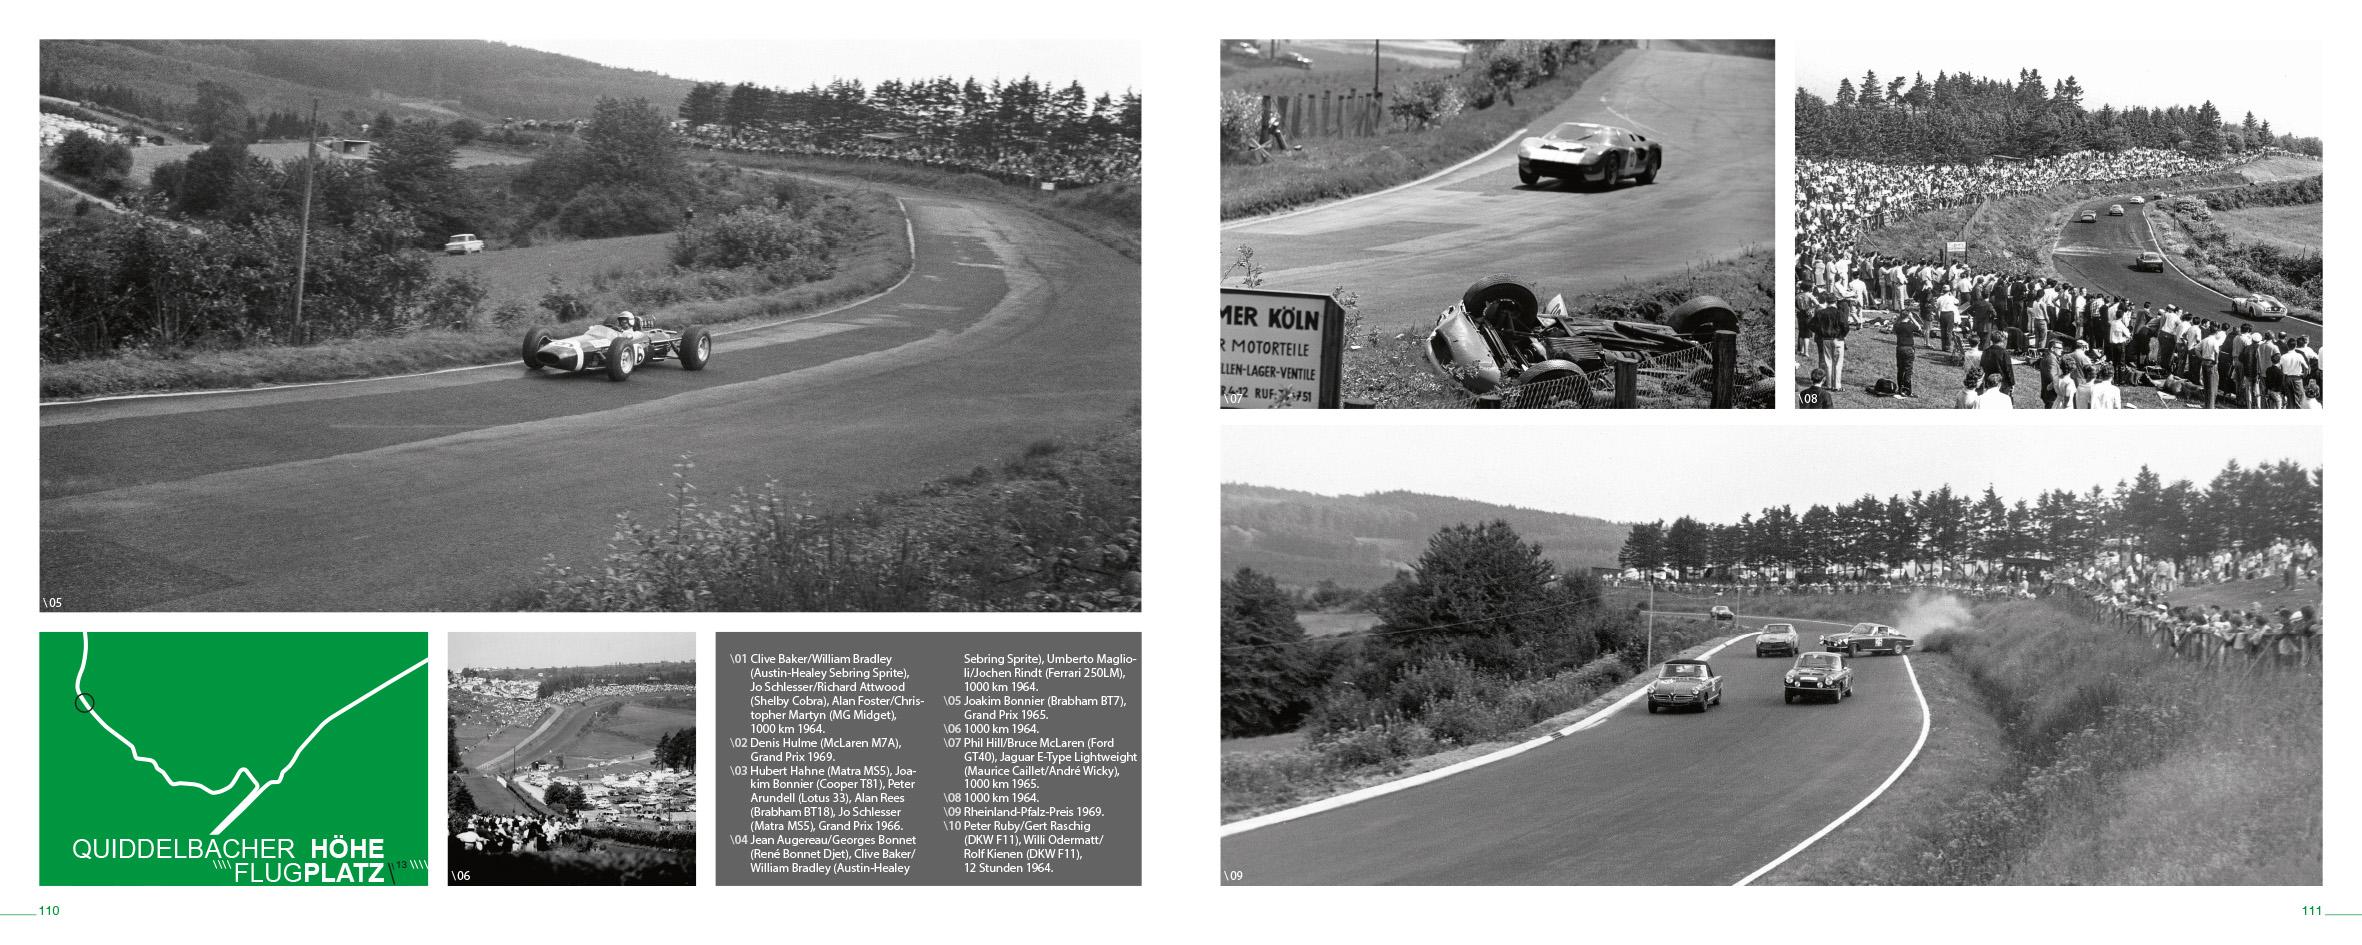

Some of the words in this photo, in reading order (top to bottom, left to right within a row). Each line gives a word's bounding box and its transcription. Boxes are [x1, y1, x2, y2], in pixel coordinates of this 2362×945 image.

[1269, 306, 1319, 331] KÖLN
[1232, 339, 1309, 357] MOTORTEILE
[1221, 363, 1316, 381] LLEN-LAGER-VENTILE
[729, 654, 747, 664] \01
[750, 654, 776, 664] Clive
[778, 654, 851, 667] Baker/William
[853, 654, 893, 667] Bradley
[964, 654, 1005, 667] Sebring
[1007, 654, 1045, 667] Sprite),
[1047, 654, 1094, 664] Umberto
[1096, 654, 1137, 667] Maglio-
[750, 668, 828, 681] (Austin-Healey
[829, 668, 871, 681] Sebring
[872, 668, 910, 681] Sprite),
[963, 668, 1012, 681] li/Jochen
[1014, 668, 1043, 678] Rindt
[1045, 668, 1082, 681] (Ferrari
[1083, 668, 1126, 681] 250LM),
[749, 682, 763, 692] Jo
[764, 682, 857, 695] Schlesser/Richard
[859, 682, 906, 692] Attwood
[964, 682, 990, 692] 1000
[991, 682, 1009, 692] km
[1011, 682, 1039, 692] 1964.
[750, 696, 790, 709] (Shelby
[791, 696, 830, 709] Cobra),
[831, 696, 856, 706] Alan
[857, 696, 925, 709] Foster/Chris-
[943, 696, 962, 706] \05
[963, 696, 1002, 706] Joakim
[1003, 696, 1045, 706] Bonnier
[1047, 696, 1099, 709] (Brabham
[1100, 696, 1127, 709] BT7),
[750, 710, 787, 723] topher
[788, 710, 827, 723] Martyn
[829, 710, 851, 723] (MG
[853, 710, 897, 723] Midget),
[964, 710, 997, 720] Grand
[999, 710, 1019, 720] Prix
[1021, 710, 1049, 720] 1965.
[750, 724, 777, 734] 1000
[778, 724, 795, 734] km
[798, 724, 826, 734] 1964.
[943, 724, 962, 734] \06
[964, 724, 991, 734] 1000
[992, 724, 1010, 734] km
[1011, 724, 1040, 734] 1964.
[729, 738, 748, 748] \02
[750, 738, 780, 748] Denis
[782, 738, 818, 748] Hulme
[820, 738, 869, 751] (McLaren
[871, 738, 902, 751] M7A),
[943, 738, 962, 748] \07
[963, 738, 984, 748] Phil
[986, 738, 1038, 751] Hill/Bruce
[1039, 738, 1085, 748] McLaren
[1087, 738, 1115, 751] (Ford
[750, 752, 783, 762] Grand
[785, 752, 806, 762] Prix
[807, 752, 836, 762] 1969.
[964, 752, 998, 765] GT40),
[999, 752, 1036, 765] Jaguar
[1037, 752, 1072, 765] E-Type
[1074, 752, 1138, 765] Lightweight
[729, 765, 748, 776] \03
[750, 765, 788, 776] Hubert
[790, 765, 825, 776] Hahne
[827, 765, 862, 778] (Matra
[863, 765, 893, 778] MS5),
[894, 765, 917, 776] Joa-
[964, 765, 1010, 778] (Maurice
[1011, 765, 1081, 778] Caillet/André
[1082, 765, 1120, 778] Wicky),
[750, 779, 771, 790] kim
[772, 779, 814, 790] Bonnier
[816, 779, 858, 792] (Cooper
[859, 779, 886, 792] T81),
[887, 779, 917, 790] Peter
[964, 779, 990, 790] 1000
[992, 779, 1010, 790] km
[1011, 779, 1040, 790] 1965.
[750, 793, 796, 804] Arundell
[798, 793, 830, 806] (Lotus
[832, 793, 852, 806] 33),
[854, 793, 879, 804] Alan
[880, 793, 905, 804] Rees
[943, 793, 962, 804] \08
[964, 793, 991, 804] 1000
[992, 793, 1010, 804] km
[1011, 793, 1040, 804] 1964.
[750, 807, 802, 820] (Brabham
[803, 807, 836, 820] BT18),
[838, 807, 851, 818] Jo
[852, 807, 902, 818] Schlesser
[943, 807, 962, 818] \09
[963, 807, 1074, 818] Rheinland-Pfalz-Preis
[1076, 807, 1105, 818] 1969.
[750, 821, 785, 834] (Matra
[787, 821, 816, 834] MS5),
[818, 821, 851, 832] Grand
[853, 821, 874, 832] Prix
[875, 821, 904, 832] 1966.
[943, 821, 962, 832] \10
[963, 821, 992, 832] Peter
[993, 821, 1048, 834] Ruby/Gert
[1050, 821, 1091, 834] Raschig
[72, 838, 295, 859] QUIDDELBACHER
[311, 834, 385, 859] HÖHE
[729, 835, 749, 846] \04
[750, 835, 775, 846] Jean
[776, 835, 876, 848] Augereau/Georges
[878, 835, 917, 846] Bonnet
[964, 835, 994, 848] (DKW
[996, 835, 1022, 848] F11),
[1023, 835, 1047, 846] Willi
[1048, 835, 1105, 848] Odermatt/
[750, 849, 781, 862] (René
[783, 849, 822, 860] Bonnet
[823, 849, 852, 862] Djet),
[854, 849, 880, 860] Clive
[882, 849, 917, 862] Baker/
[963, 849, 985, 860] Rolf
[986, 849, 1024, 860] Kienen
[1026, 849, 1056, 862] (DKW
[1058, 849, 1083, 862] F11),
[235, 863, 385, 883] FLUGPLATZ
[750, 863, 790, 873] William
[791, 863, 832, 876] Bradley
[833, 863, 911, 876] (Austin-Healey
[964, 863, 977, 873] 12
[979, 863, 1024, 873] Stunden
[1026, 863, 1054, 873] 1964.
[38, 905, 60, 916] 110
[2302, 905, 2321, 916] 111
